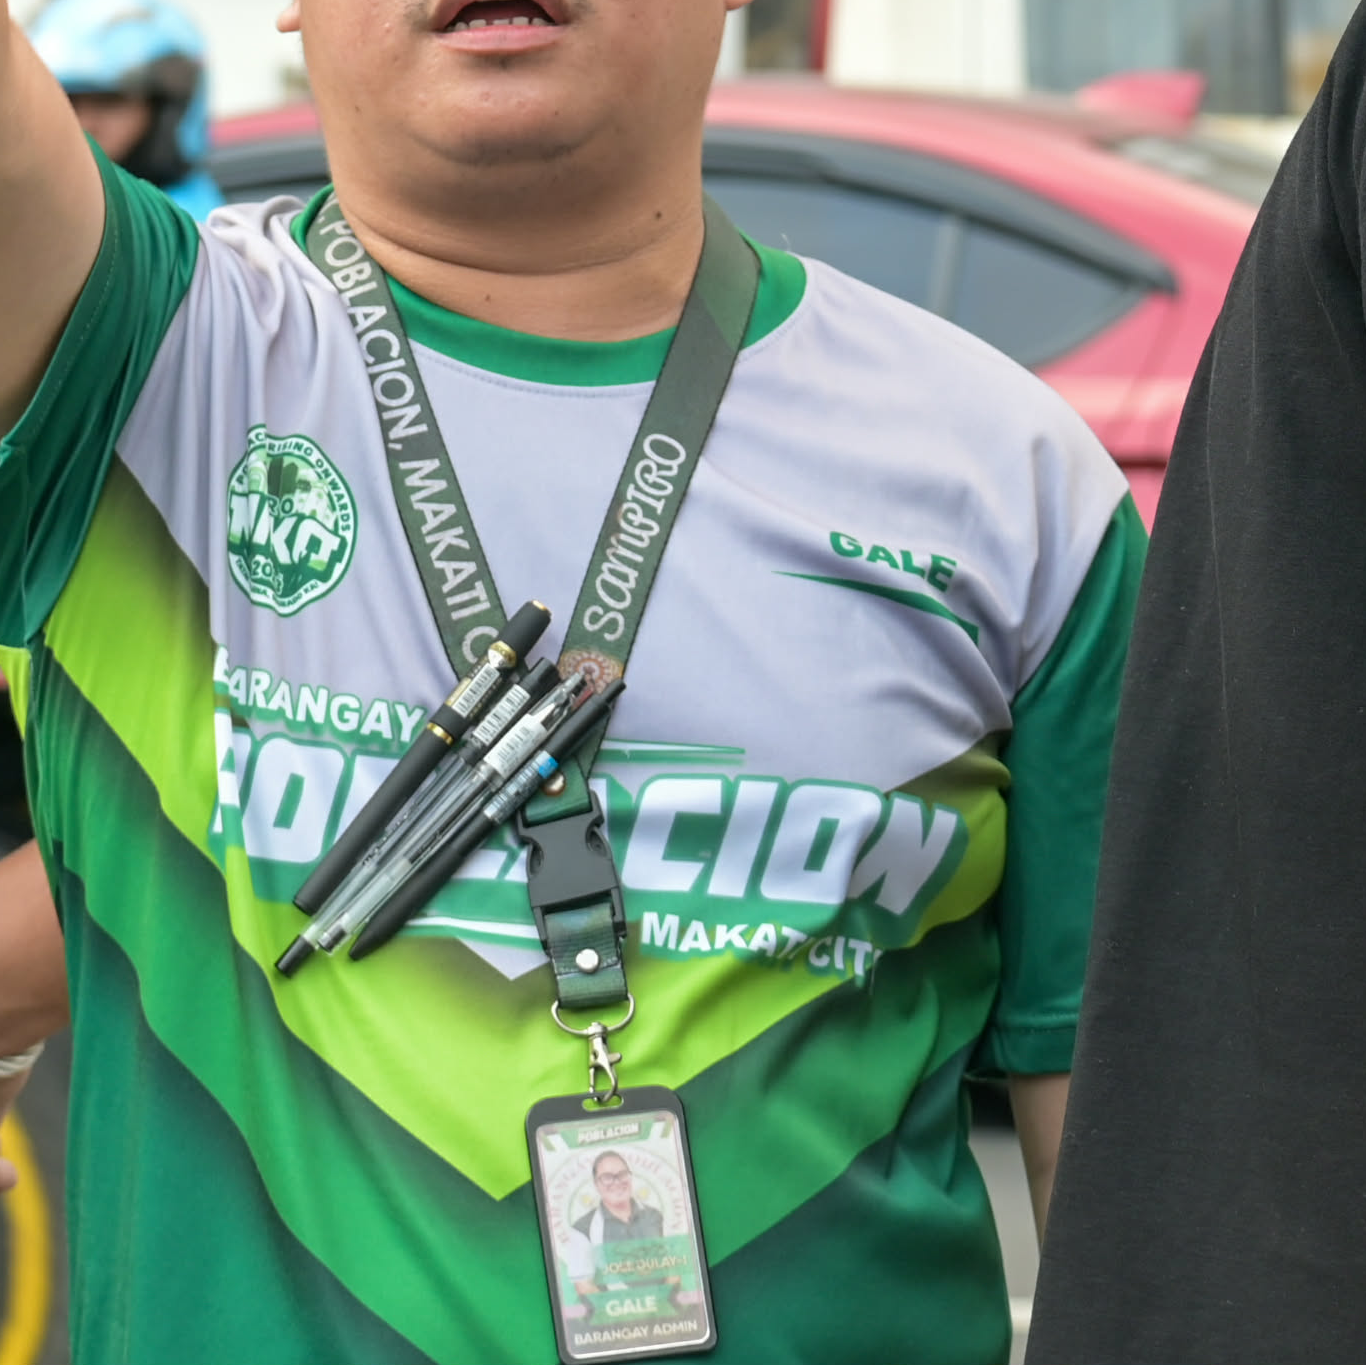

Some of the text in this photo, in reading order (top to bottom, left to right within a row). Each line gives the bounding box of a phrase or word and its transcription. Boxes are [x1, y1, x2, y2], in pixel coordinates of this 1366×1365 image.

[315, 458, 351, 533] ONWARDS
[398, 458, 492, 621] MAKATI
[829, 530, 957, 594] GALE
[211, 710, 958, 916] POCION
[574, 1319, 698, 1346] BARANGAY ADMIN
[605, 1295, 658, 1317] GALE
